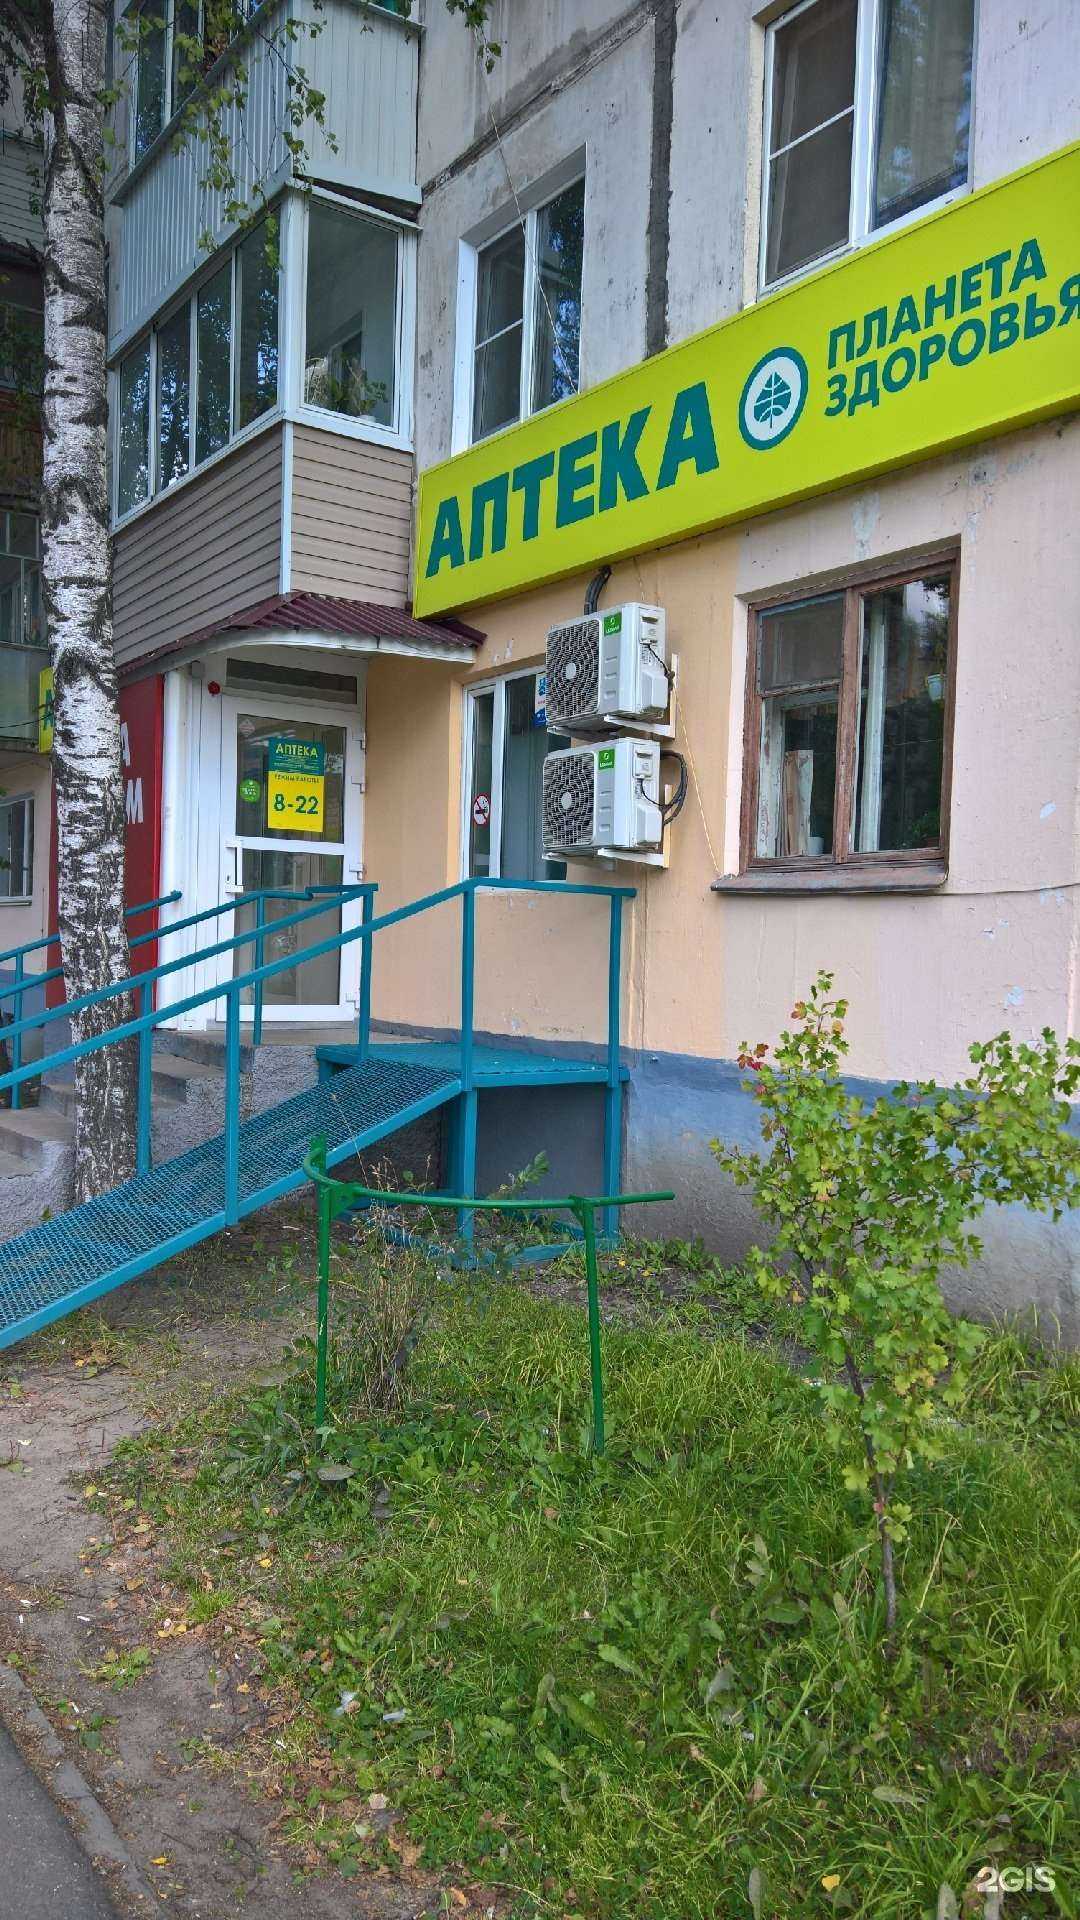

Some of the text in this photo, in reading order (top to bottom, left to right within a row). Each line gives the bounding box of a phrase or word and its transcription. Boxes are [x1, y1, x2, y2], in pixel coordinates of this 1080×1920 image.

[823, 273, 1080, 417] ЗДОРОВЬЯ
[827, 238, 1047, 370] ПЛАНЕТА
[426, 383, 720, 578] АПТЕКА
[274, 793, 319, 815] 8-22
[275, 743, 318, 758] АПТЕКА
